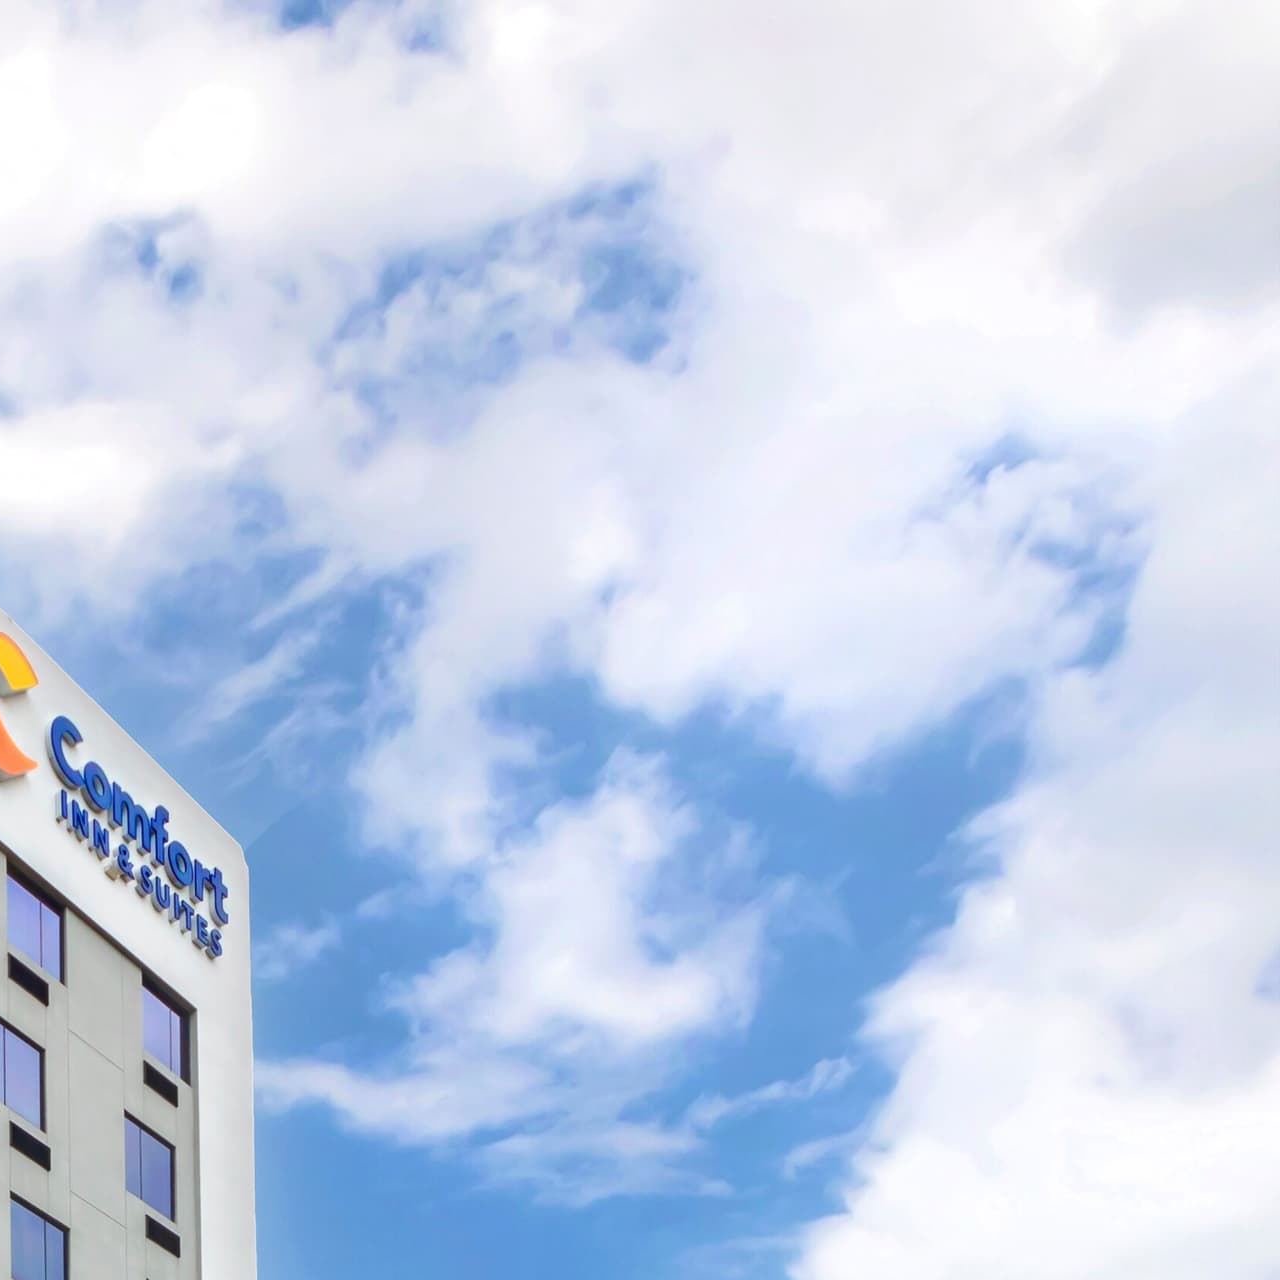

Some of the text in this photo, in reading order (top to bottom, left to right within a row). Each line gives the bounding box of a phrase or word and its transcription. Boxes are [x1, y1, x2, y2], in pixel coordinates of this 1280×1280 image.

[47, 715, 229, 926] Comfort
[56, 789, 223, 960] INN & SUITES
